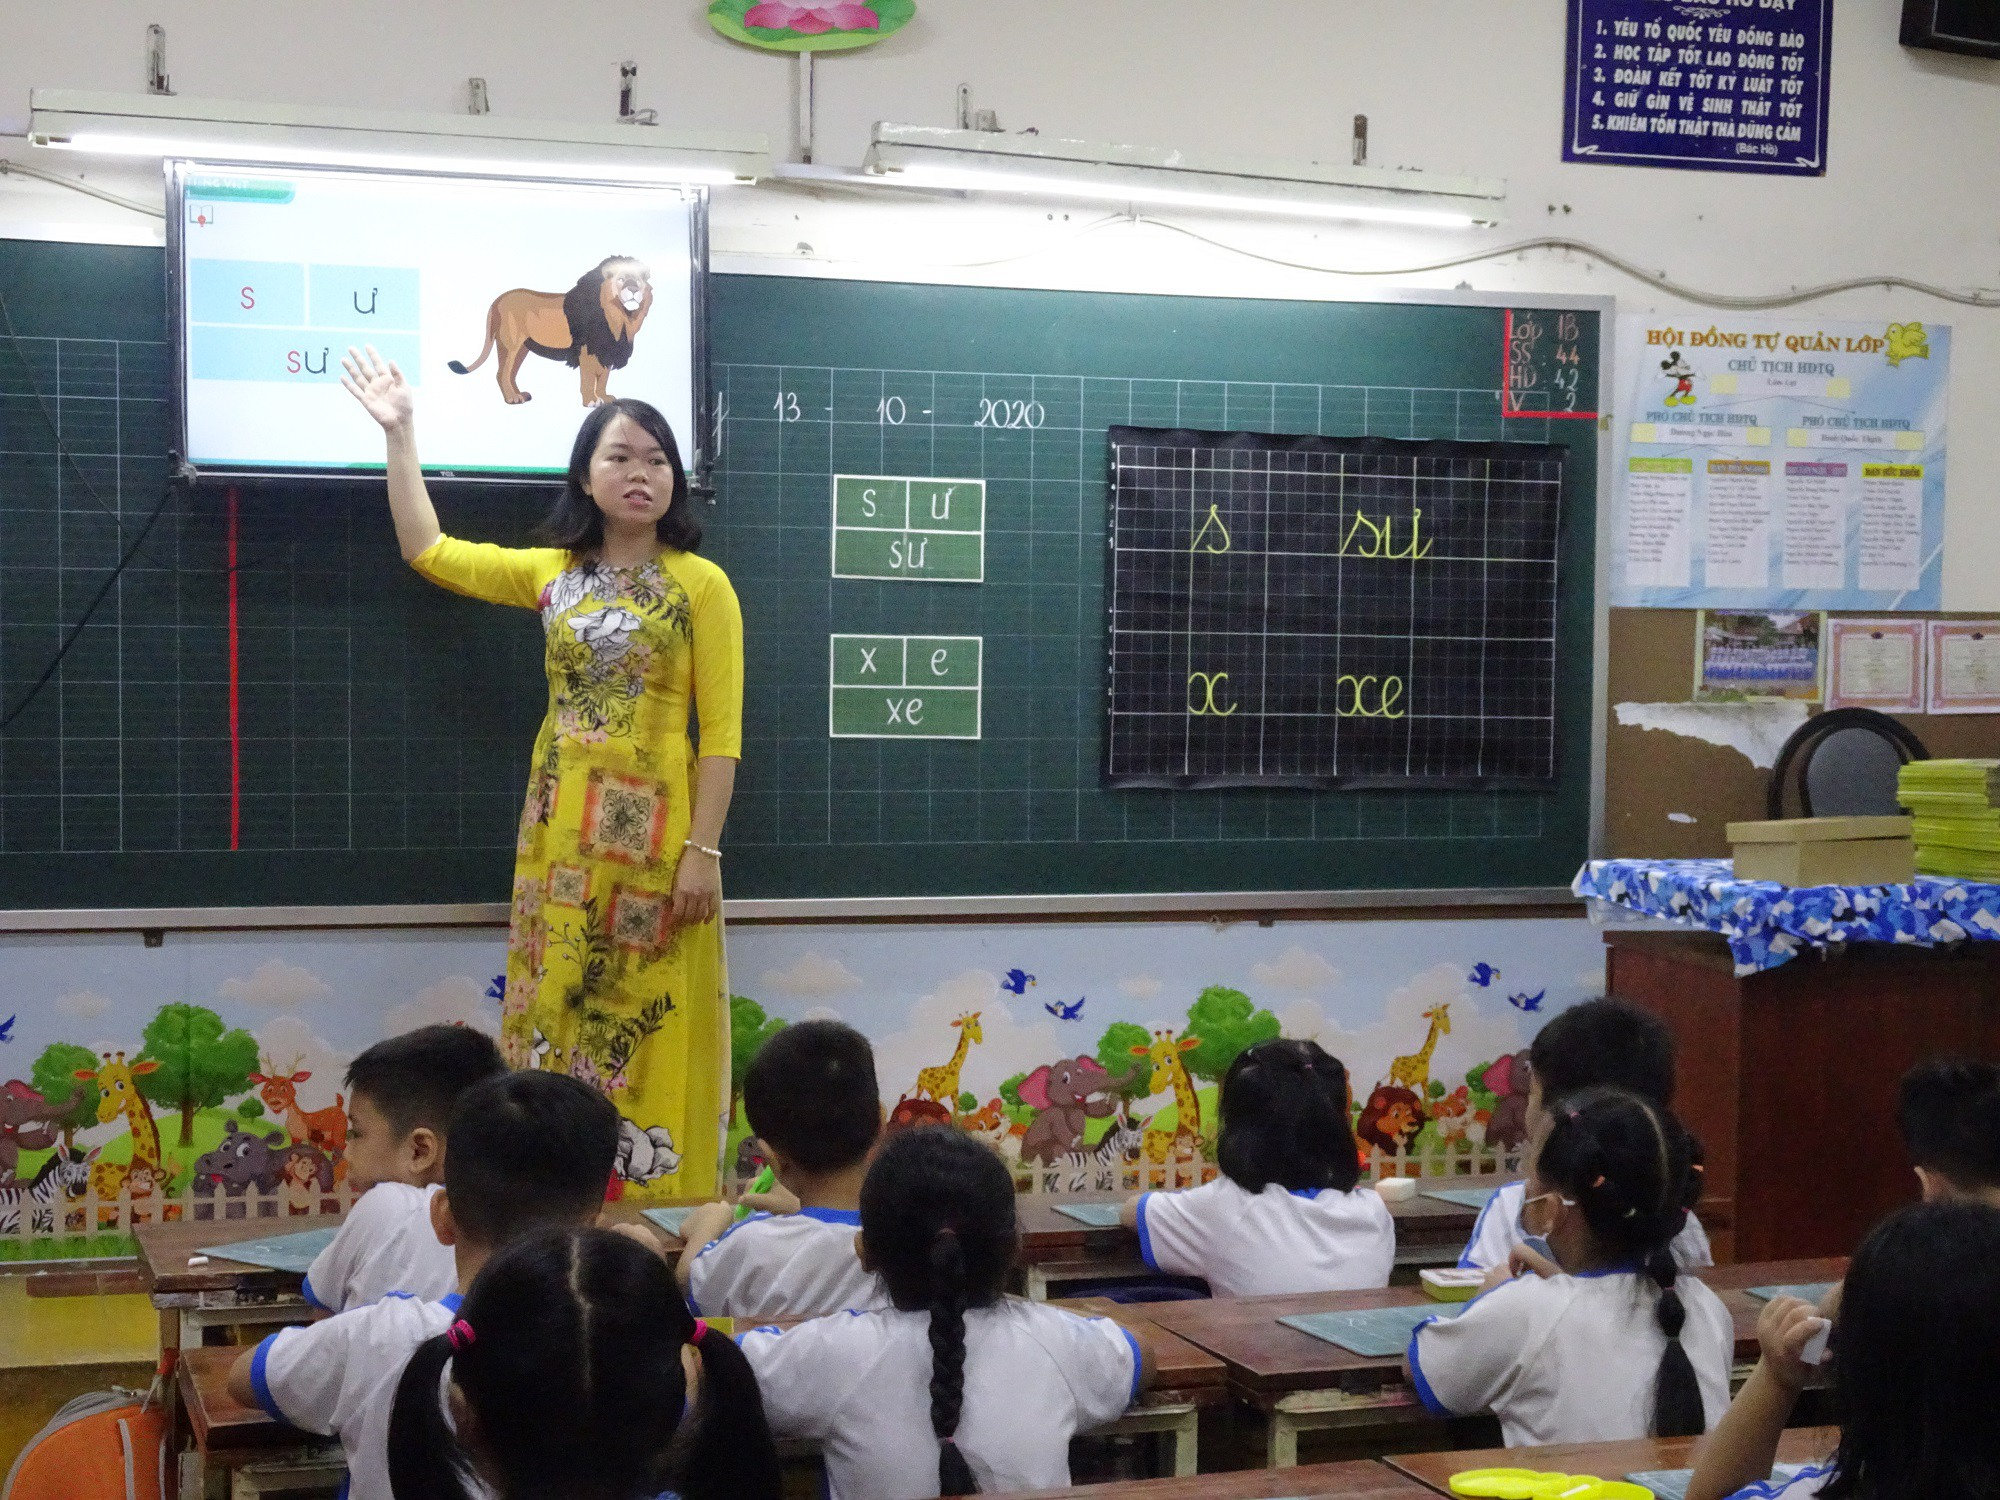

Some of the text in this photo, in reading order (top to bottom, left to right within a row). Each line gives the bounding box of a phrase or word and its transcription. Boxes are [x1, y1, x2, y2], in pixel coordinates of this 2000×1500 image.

[1667, 20, 1702, 42] QUỐC
[1613, 45, 1641, 64] HỌC
[1647, 43, 1671, 66] TẬP
[1678, 44, 1703, 65] TỐT
[1706, 51, 1732, 68] LAO
[1781, 51, 1805, 72] TỐT
[1613, 65, 1651, 86] ĐOÀN
[1658, 67, 1683, 88] KẾT
[1689, 69, 1714, 90] TỐT
[1742, 73, 1774, 95] LUẬT
[1780, 75, 1804, 96] TỐT
[1702, 97, 1733, 114] SINH
[1741, 95, 1772, 117] THẬT
[1779, 97, 1804, 118] TỐT
[1606, 112, 1648, 132] KHIÊM
[1678, 115, 1710, 137] THẬT
[354, 287, 378, 315] ư
[1646, 327, 1684, 348] HỘI
[1690, 325, 1747, 349] ĐỒNG
[1752, 331, 1781, 353] TỰ
[1785, 330, 1841, 354] QUẢN
[286, 347, 330, 374] sư
[1555, 345, 1580, 365] 44
[1554, 368, 1579, 392] 42
[773, 392, 801, 423] 13
[876, 396, 907, 425] 10
[974, 398, 1045, 430] 2020
[889, 537, 928, 569] sư
[1335, 675, 1404, 719] xe
[886, 698, 924, 725] xe
